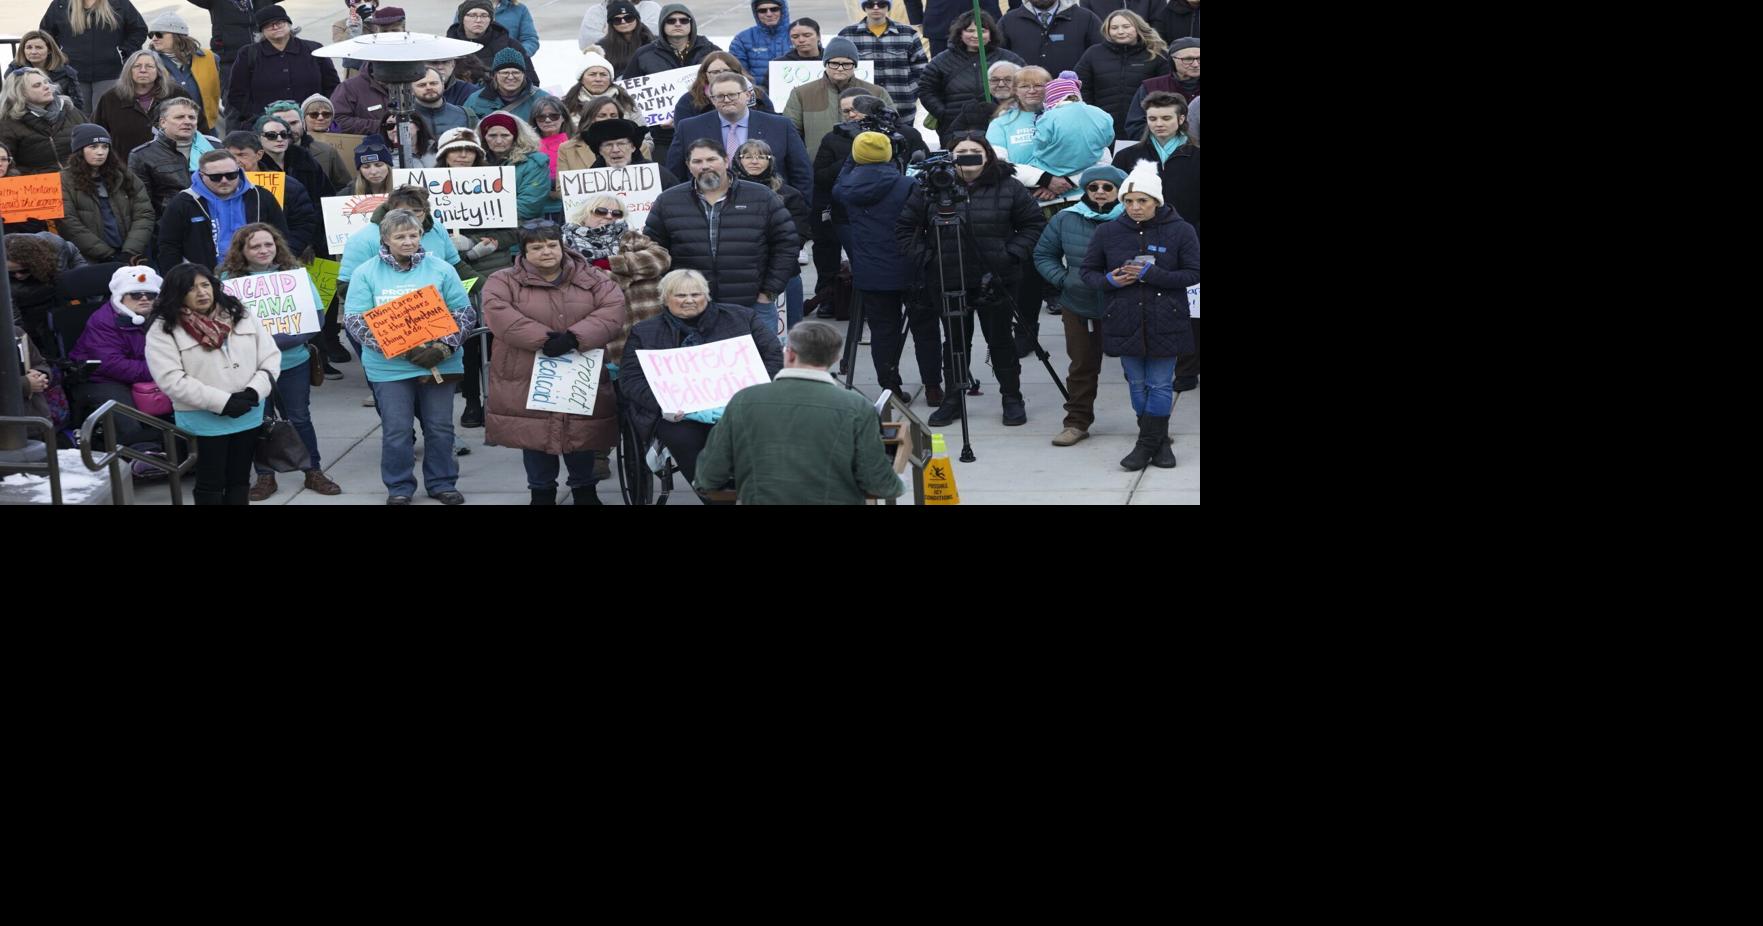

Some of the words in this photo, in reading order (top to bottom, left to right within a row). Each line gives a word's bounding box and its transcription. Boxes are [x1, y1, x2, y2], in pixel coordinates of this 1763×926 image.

[620, 77, 650, 90] EEP
[630, 83, 676, 101] ONTANA
[254, 173, 280, 186] THE
[408, 166, 510, 195] Medicaid
[562, 166, 655, 196] MEDICAID
[433, 198, 505, 227] gnity!!!
[223, 273, 297, 301] DICAID
[243, 294, 297, 318] TANA
[262, 312, 302, 335] THY
